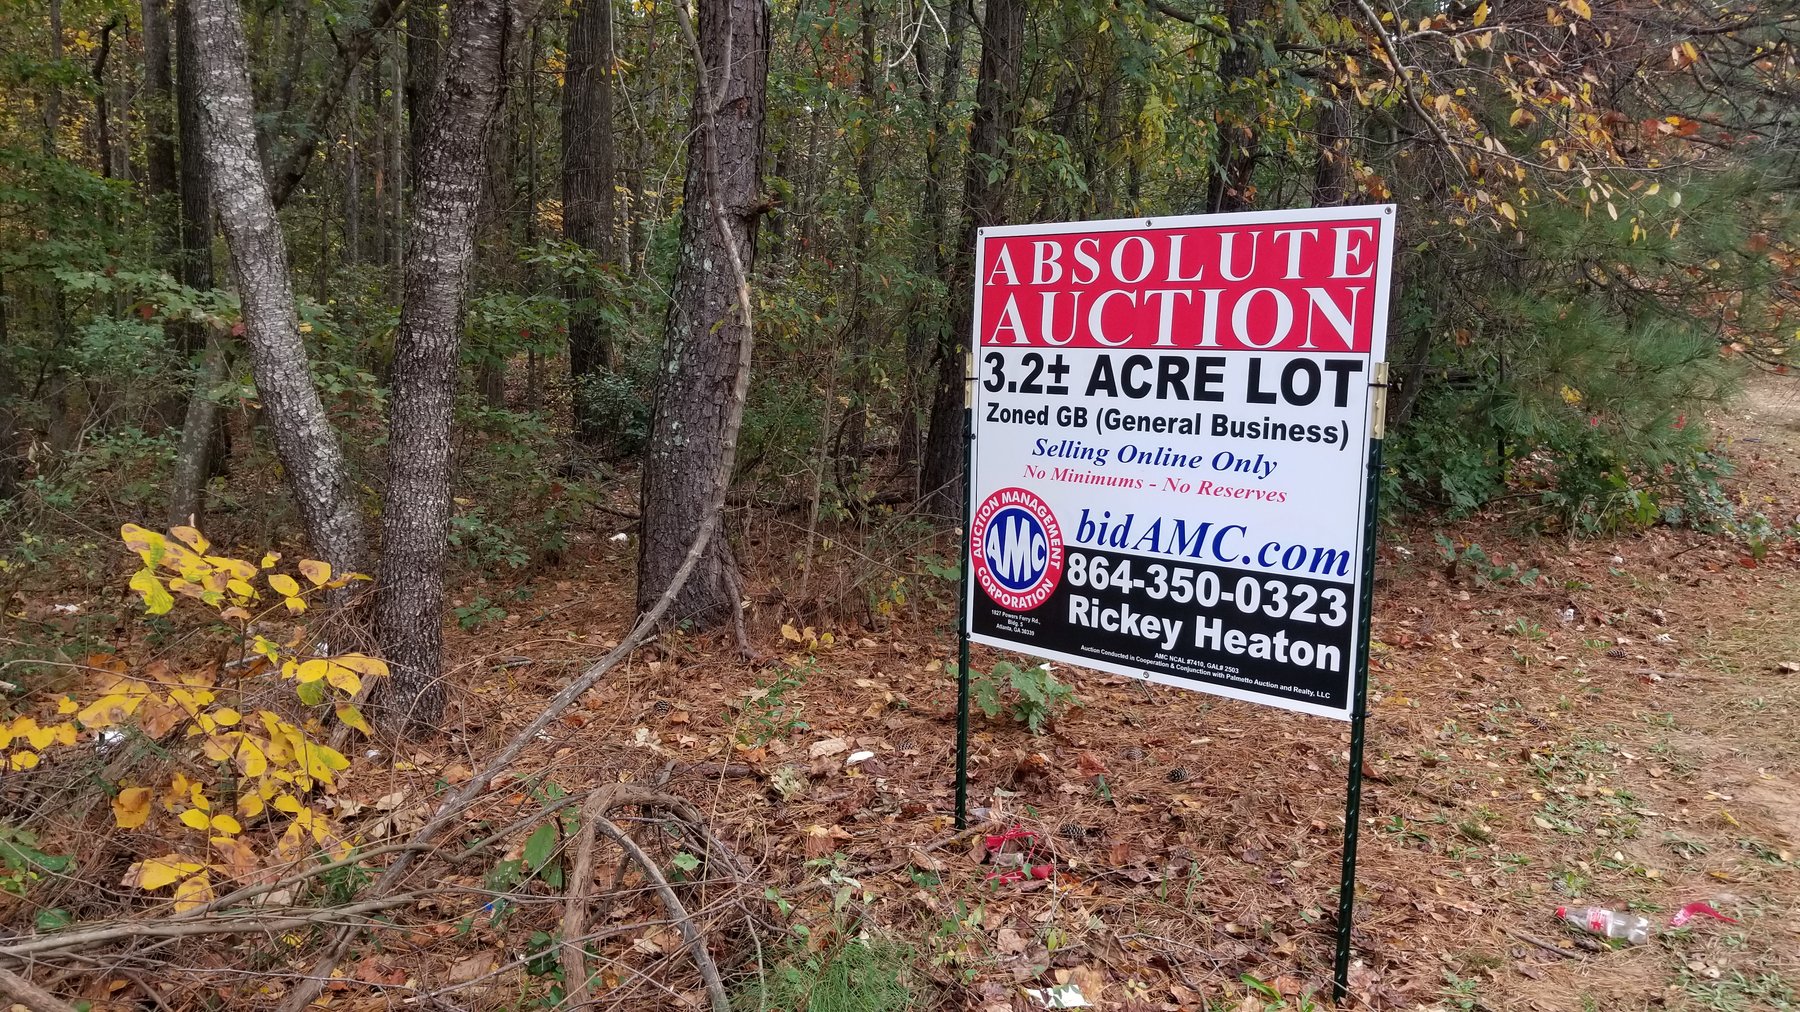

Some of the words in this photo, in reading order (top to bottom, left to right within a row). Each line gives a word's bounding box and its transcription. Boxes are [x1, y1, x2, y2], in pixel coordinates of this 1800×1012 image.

[985, 226, 1374, 286] ABSOLUTE
[987, 286, 1366, 350] AUCTION
[983, 351, 1070, 396] 3.2±
[1085, 354, 1227, 402] ACRE
[1246, 357, 1363, 408] LOT
[986, 402, 1049, 426] Zoned
[1056, 406, 1088, 428] GB
[1096, 407, 1201, 436] (General
[1211, 414, 1349, 451] Business)
[1023, 464, 1046, 481] No
[1050, 466, 1144, 490] Minimums
[1162, 477, 1191, 494] No
[1197, 480, 1288, 504] Reserves
[1032, 438, 1109, 466] Selling
[1117, 444, 1203, 469] Online
[1211, 451, 1278, 480] Only
[973, 496, 999, 558] AUCTION
[1001, 490, 1061, 570] MANAGEMENT
[986, 515, 1046, 583] AMC
[1076, 508, 1351, 577] bidAMC.com
[978, 566, 1054, 609] CORPORATION
[1002, 611, 1018, 620] Powers
[1067, 552, 1348, 627] 864-350-0323
[1068, 593, 1183, 651] Rickey
[1194, 615, 1341, 672] Heaton
[1080, 644, 1100, 654] Auction
[1100, 648, 1129, 660] Conducted
[1136, 656, 1170, 668] Cooperation
[1176, 664, 1211, 676] Conjunction
[1212, 671, 1225, 679] with
[1226, 674, 1253, 684] Palmetto
[1254, 679, 1279, 689] Auction
[1279, 684, 1292, 692] and
[1316, 691, 1331, 699] LLC
[1154, 652, 1169, 660] AMC
[1169, 655, 1186, 664] NCAL
[1206, 662, 1224, 671] GAL#
[1224, 665, 1240, 674] 2503
